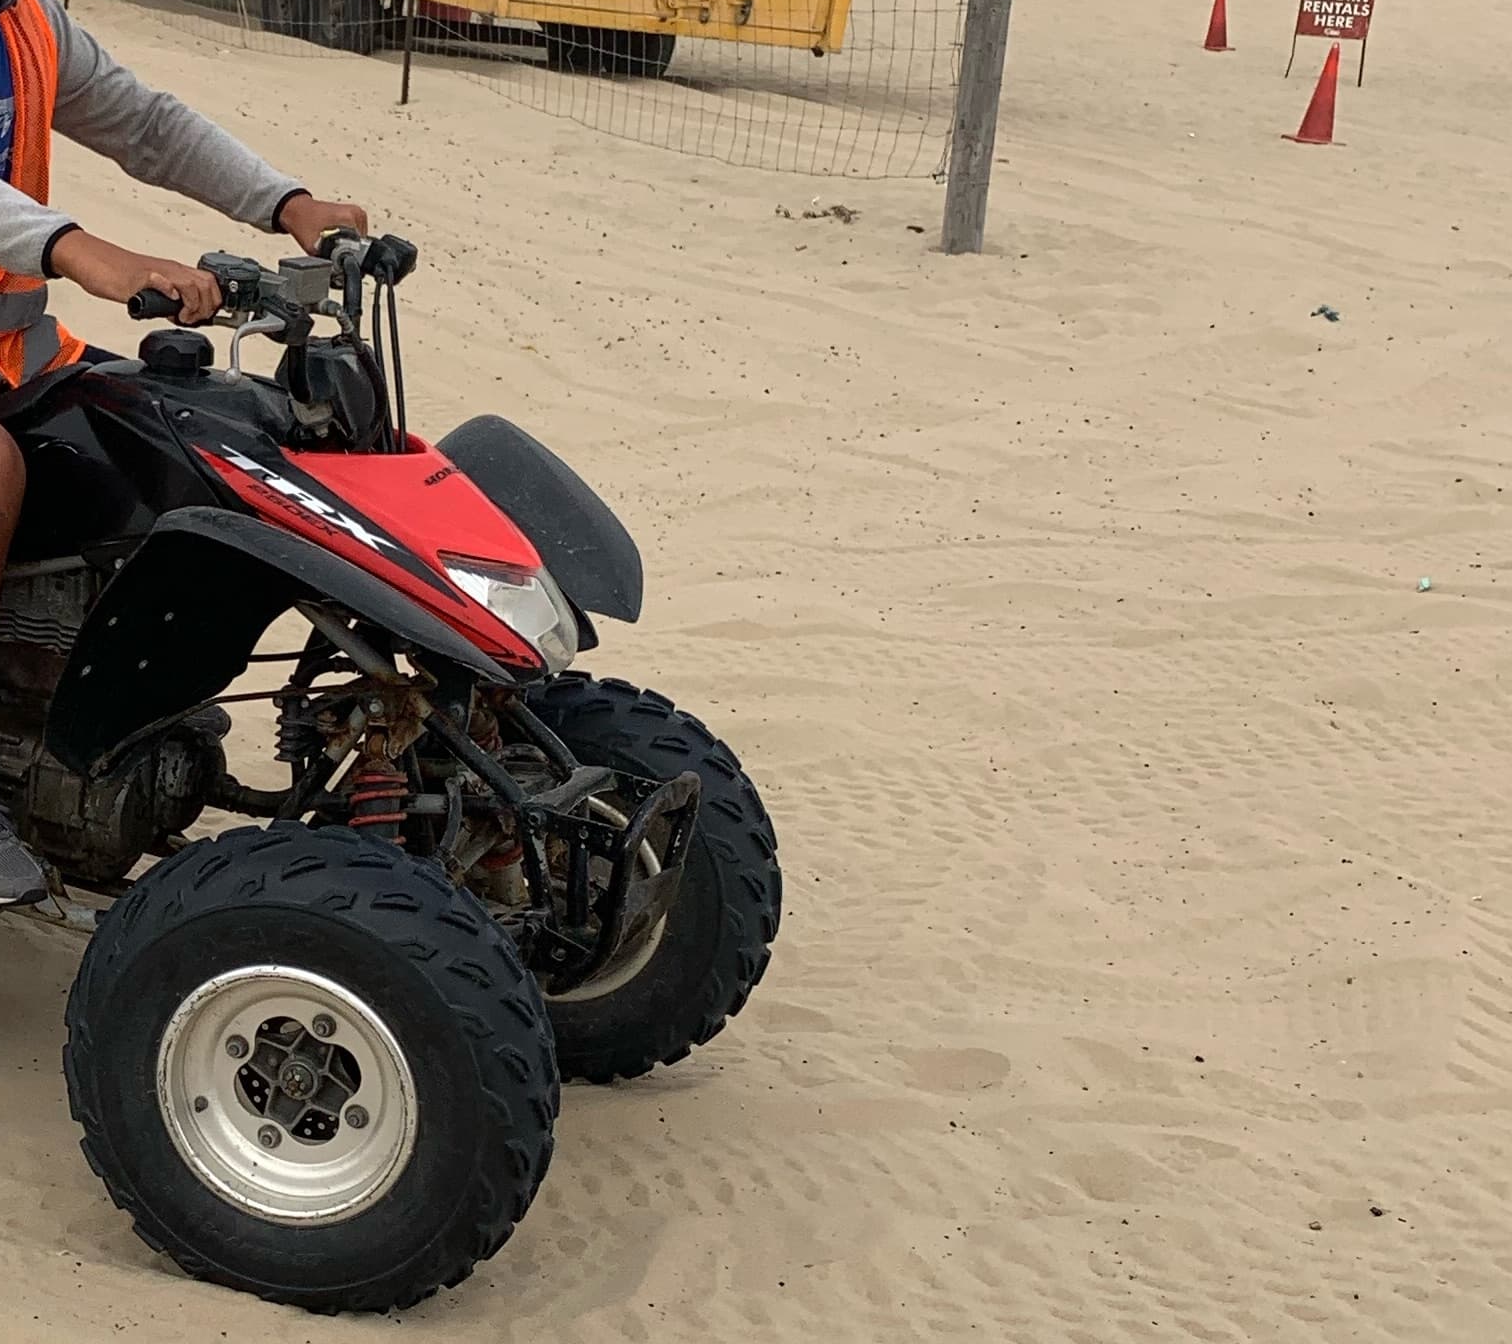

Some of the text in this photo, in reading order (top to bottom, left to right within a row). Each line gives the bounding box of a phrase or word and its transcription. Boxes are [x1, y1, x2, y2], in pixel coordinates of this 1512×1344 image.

[1302, 0, 1371, 17] RENTALS
[1313, 13, 1355, 29] HERE
[221, 444, 402, 555] TRX
